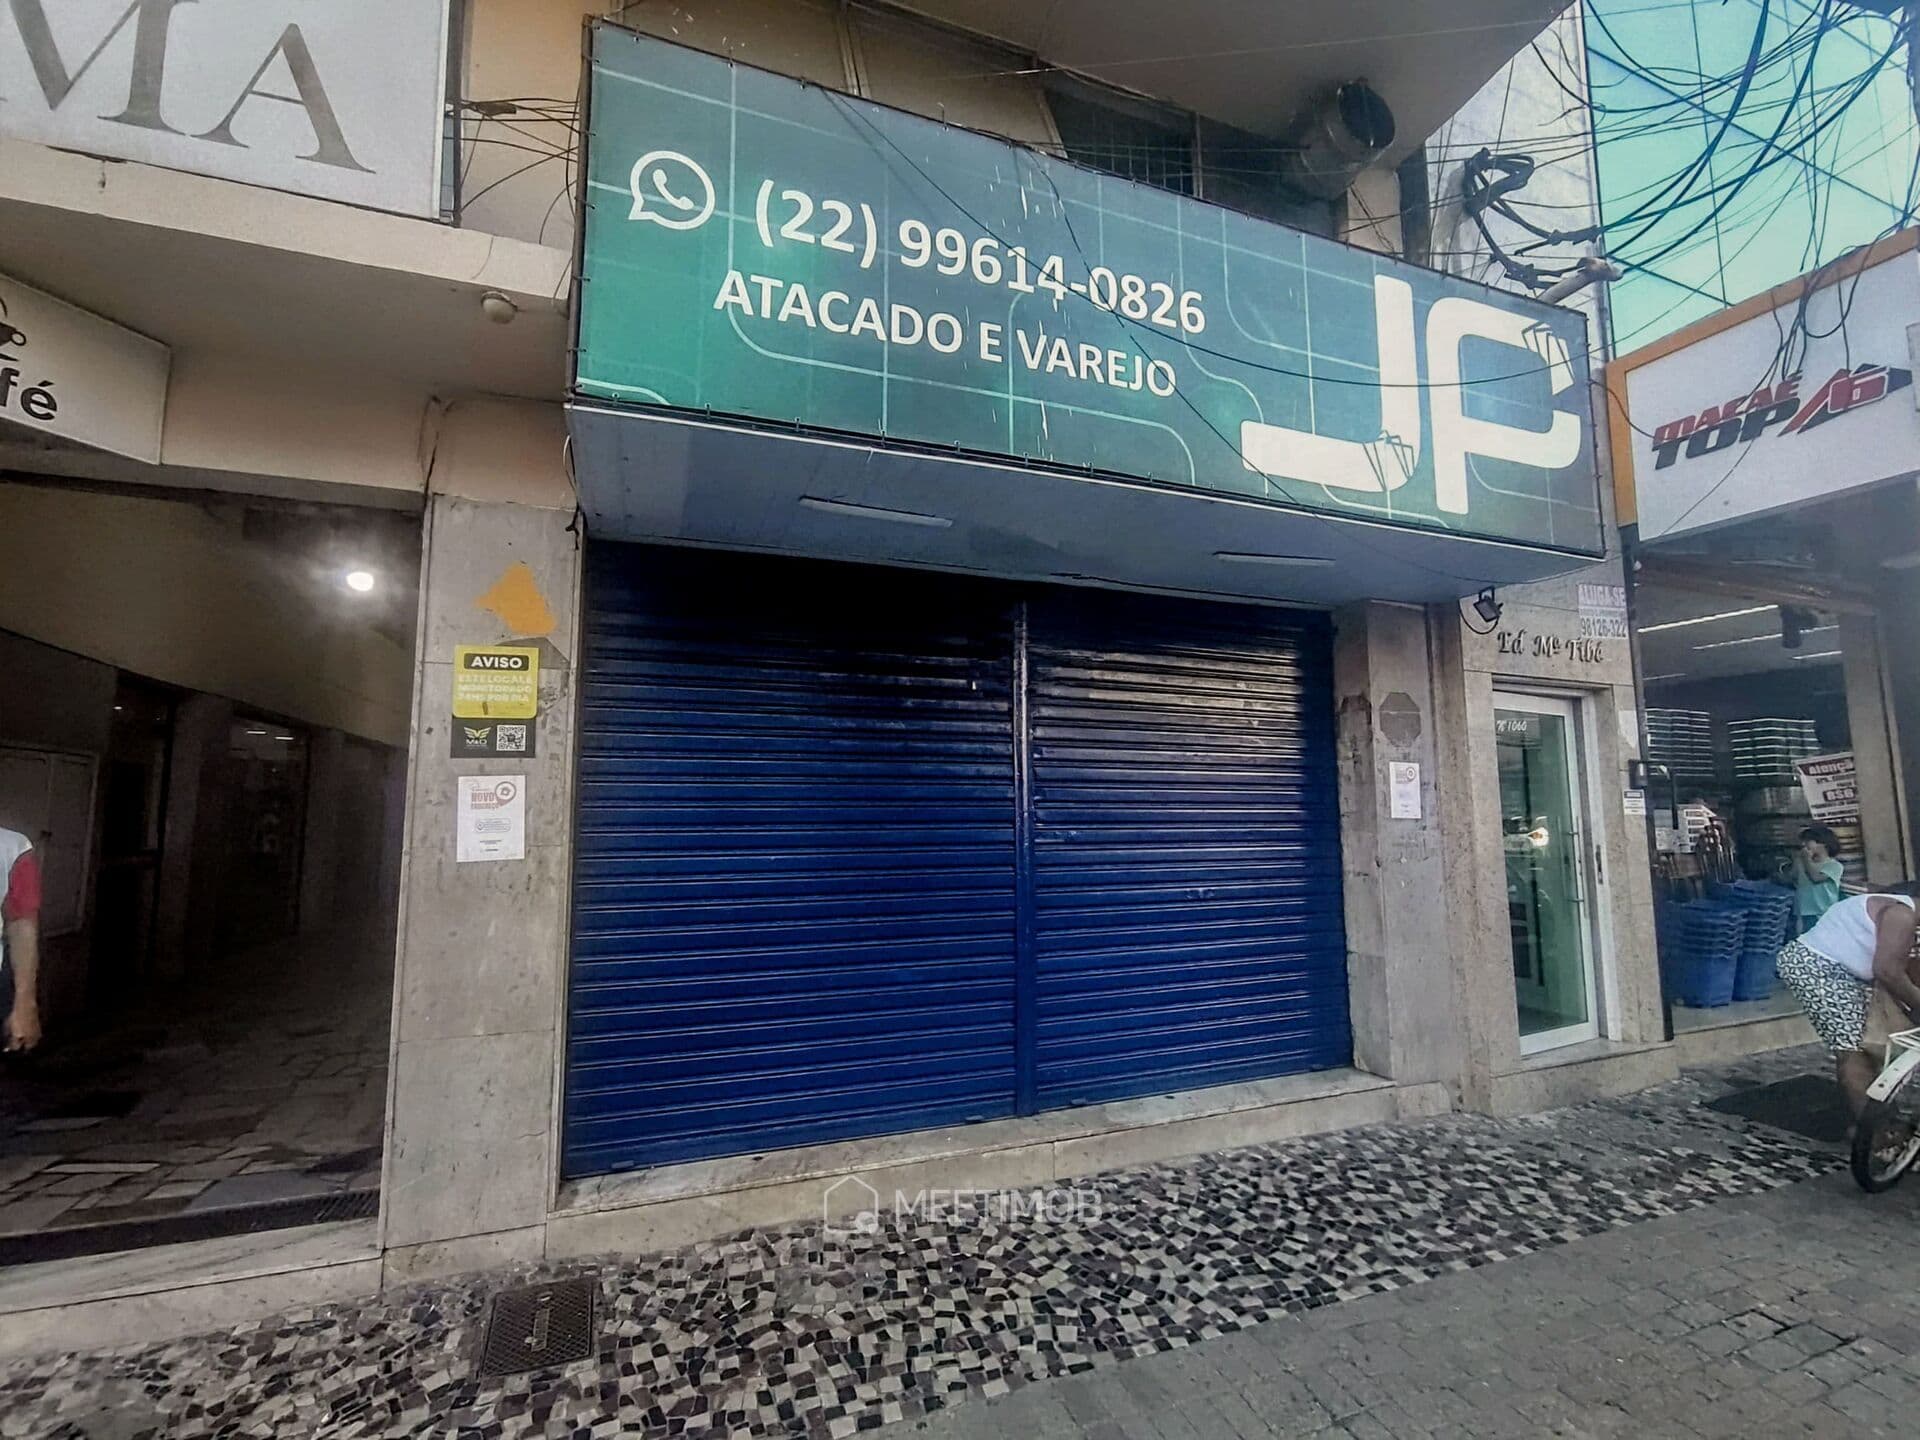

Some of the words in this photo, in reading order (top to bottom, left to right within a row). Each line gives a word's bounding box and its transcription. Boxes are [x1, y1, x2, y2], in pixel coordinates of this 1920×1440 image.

[755, 179, 878, 268] (22)
[898, 219, 1206, 334] 99614-0826
[713, 270, 963, 353] ATACADO
[979, 321, 1003, 363] E
[1016, 328, 1177, 397] VAREJO
[1651, 397, 1801, 470] TOP
[471, 656, 522, 669] AVISO
